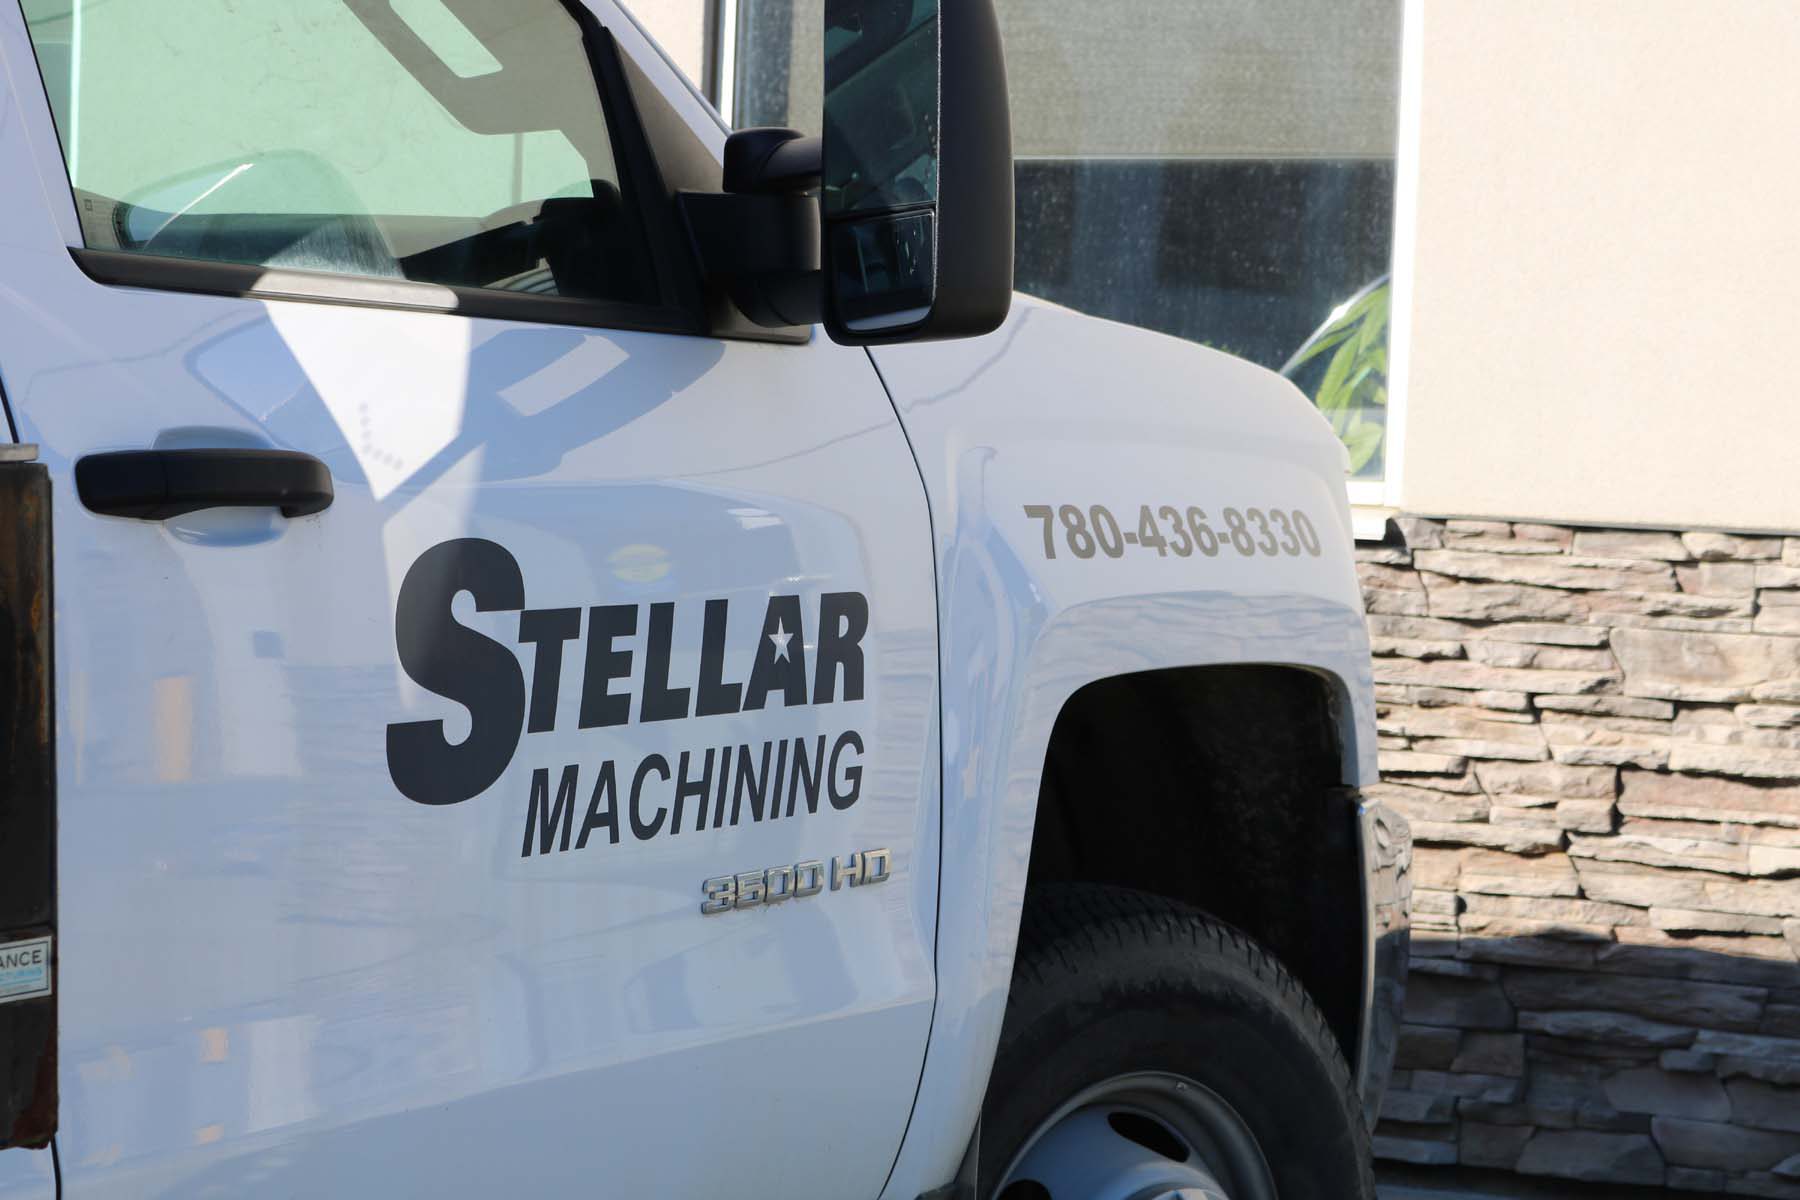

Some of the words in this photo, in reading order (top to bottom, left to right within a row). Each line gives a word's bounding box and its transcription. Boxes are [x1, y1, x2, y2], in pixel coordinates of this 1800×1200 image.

[1023, 504, 1321, 559] 780-436-8330
[386, 537, 868, 805] STELLAR
[521, 730, 865, 858] MACHINING
[701, 860, 824, 914] 3500
[830, 848, 891, 891] HD
